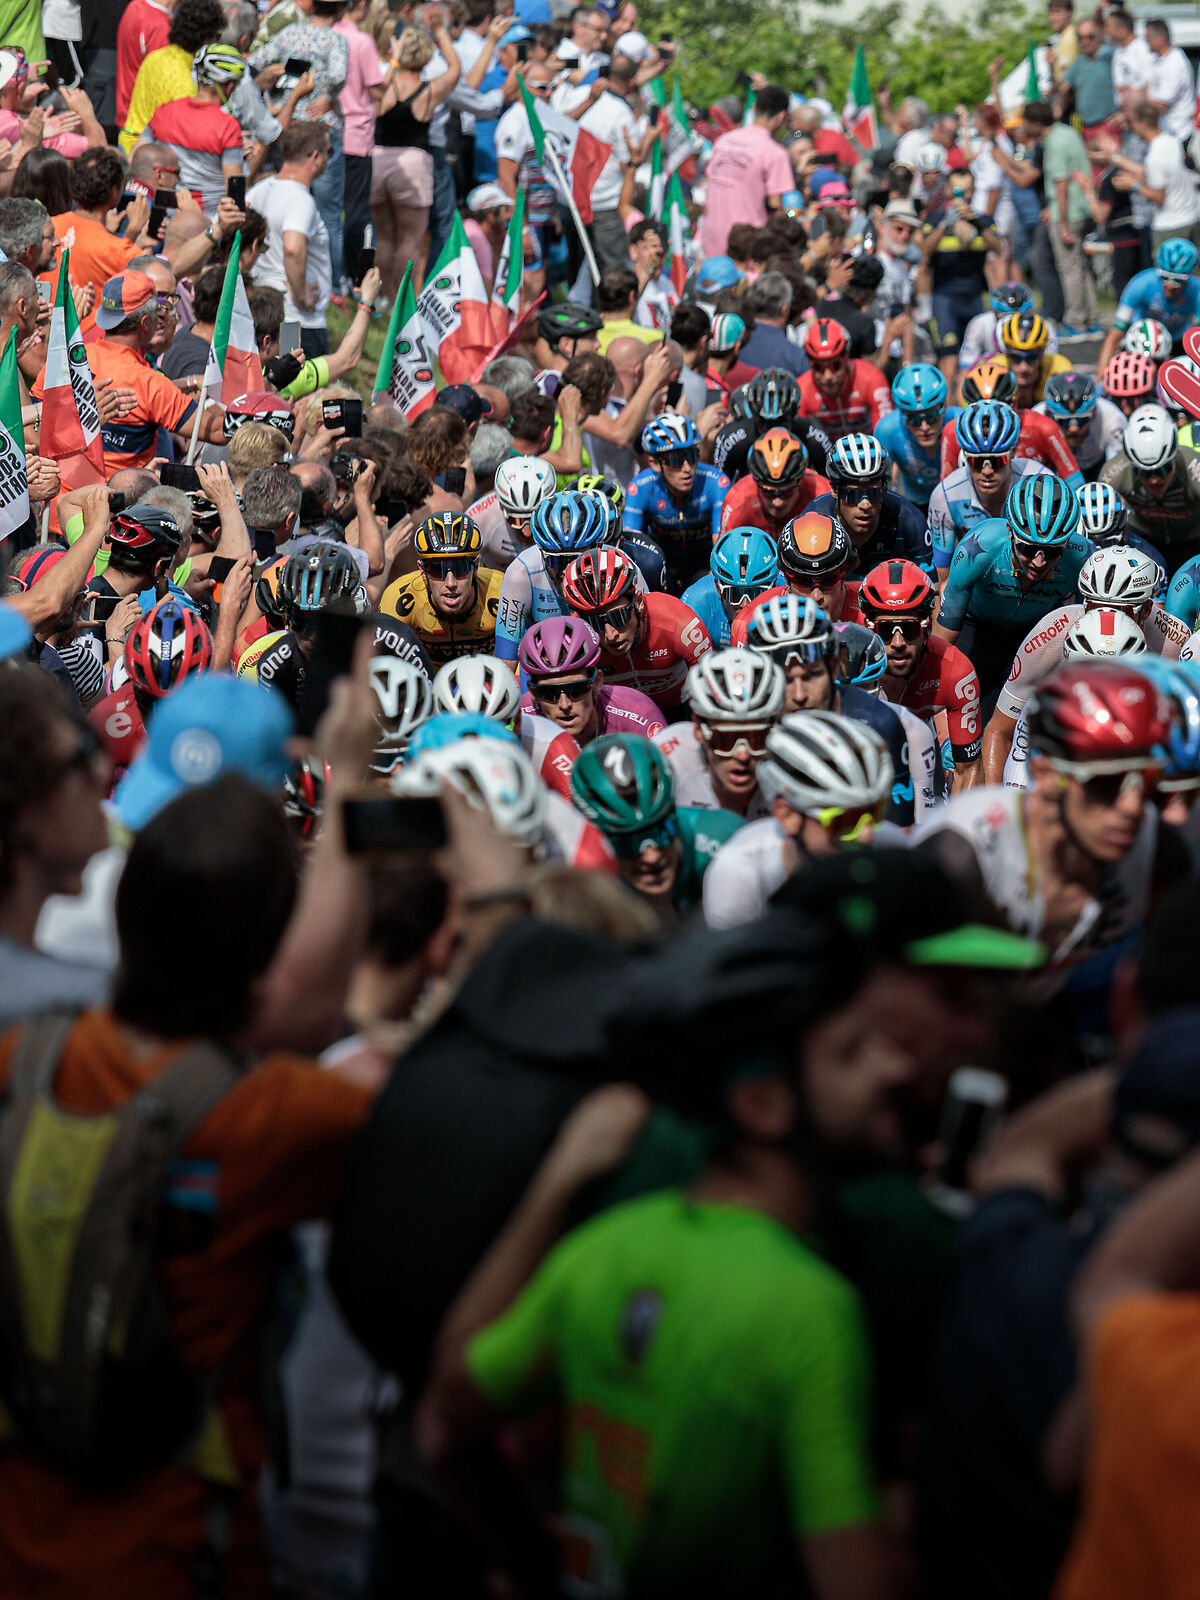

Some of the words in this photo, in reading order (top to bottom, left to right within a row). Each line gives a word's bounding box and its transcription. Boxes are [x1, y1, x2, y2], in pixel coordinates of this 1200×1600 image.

[953, 550, 965, 567] ERG
[1174, 577, 1190, 593] ERG
[507, 599, 520, 637] ALULA
[1024, 614, 1069, 655] CITROËN
[1154, 616, 1188, 648] MONDIA
[1157, 610, 1178, 629] AG2R
[1180, 625, 1192, 636] LA
[373, 625, 432, 687] youfo
[649, 648, 668, 659] CAPS
[955, 670, 980, 734] lotto
[1011, 720, 1028, 762] Cofi
